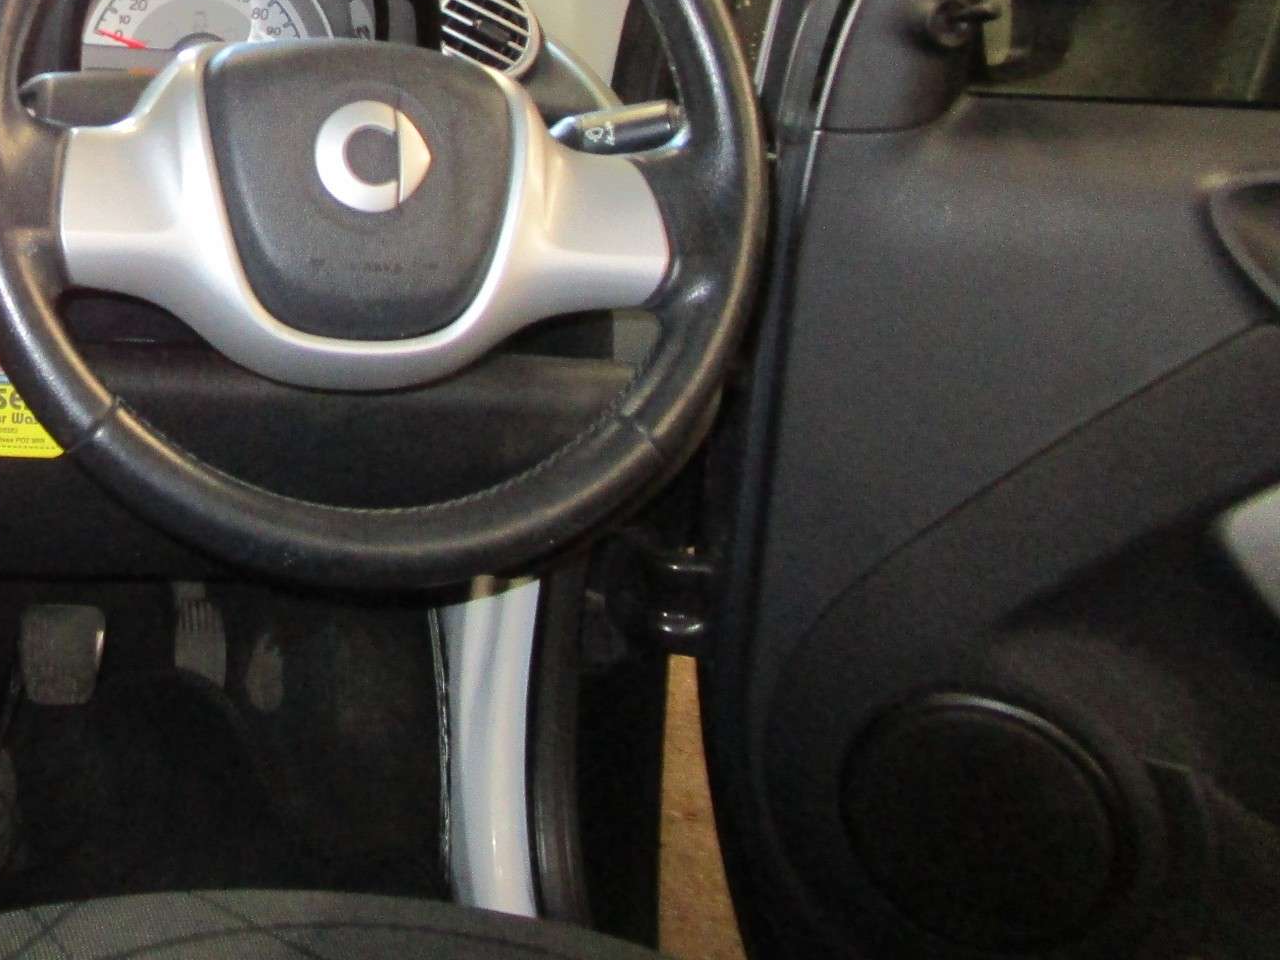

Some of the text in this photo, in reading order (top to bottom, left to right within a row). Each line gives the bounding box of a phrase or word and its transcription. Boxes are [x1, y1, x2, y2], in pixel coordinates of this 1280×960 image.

[129, 0, 148, 11] 20
[251, 8, 269, 20] 80
[119, 15, 131, 25] 10
[266, 26, 282, 36] 90
[11, 412, 41, 425] Wa
